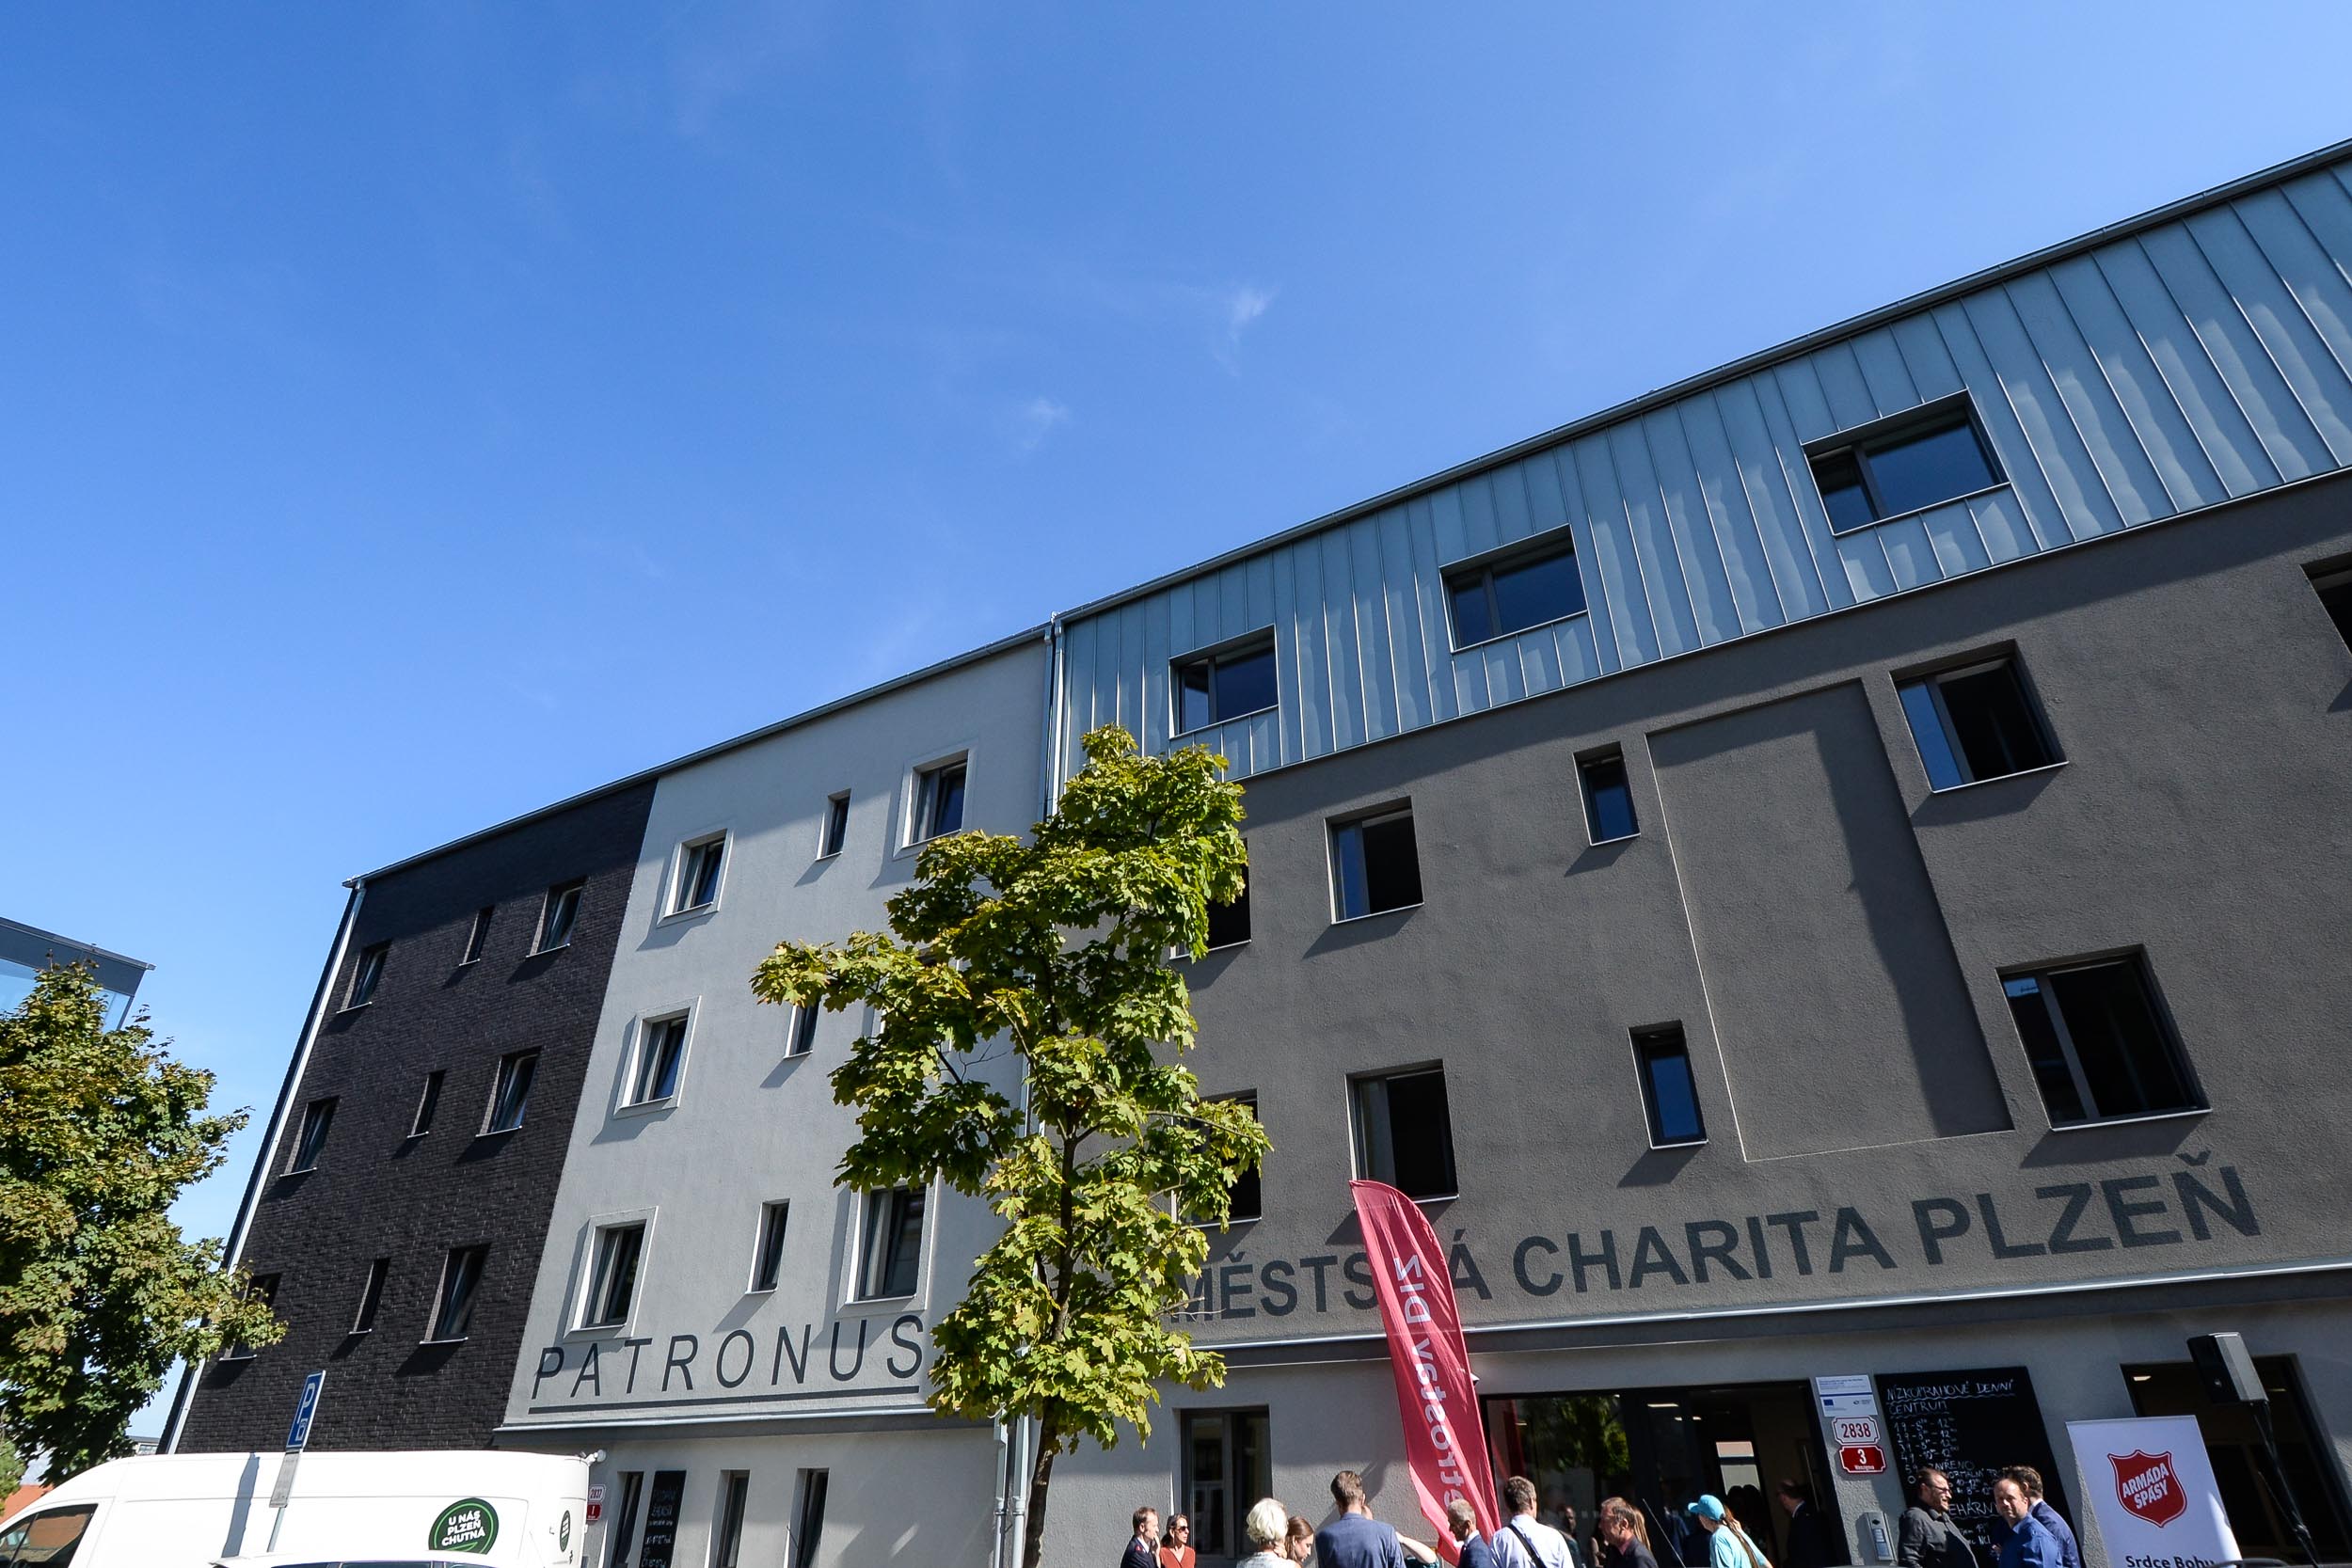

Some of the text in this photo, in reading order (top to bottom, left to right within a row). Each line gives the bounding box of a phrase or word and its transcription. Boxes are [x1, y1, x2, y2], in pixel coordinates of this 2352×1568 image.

[1170, 1149, 2262, 1323] MĚSTSÁ CHARITA PLZEŇ
[531, 1314, 924, 1400] PATRONUS
[1976, 1379, 2014, 1393] DENNÍ
[296, 1383, 316, 1423] P
[1888, 1401, 1948, 1416] CENTRUM
[1841, 1422, 1871, 1438] 2838
[1857, 1449, 1867, 1465] 3
[2122, 1462, 2169, 1498] ARMÁDA
[448, 1510, 481, 1526] U NÁS
[447, 1518, 482, 1536] PLZEŇ
[441, 1526, 486, 1546] CHUTNÁ
[2124, 1555, 2170, 1568] Srdce
